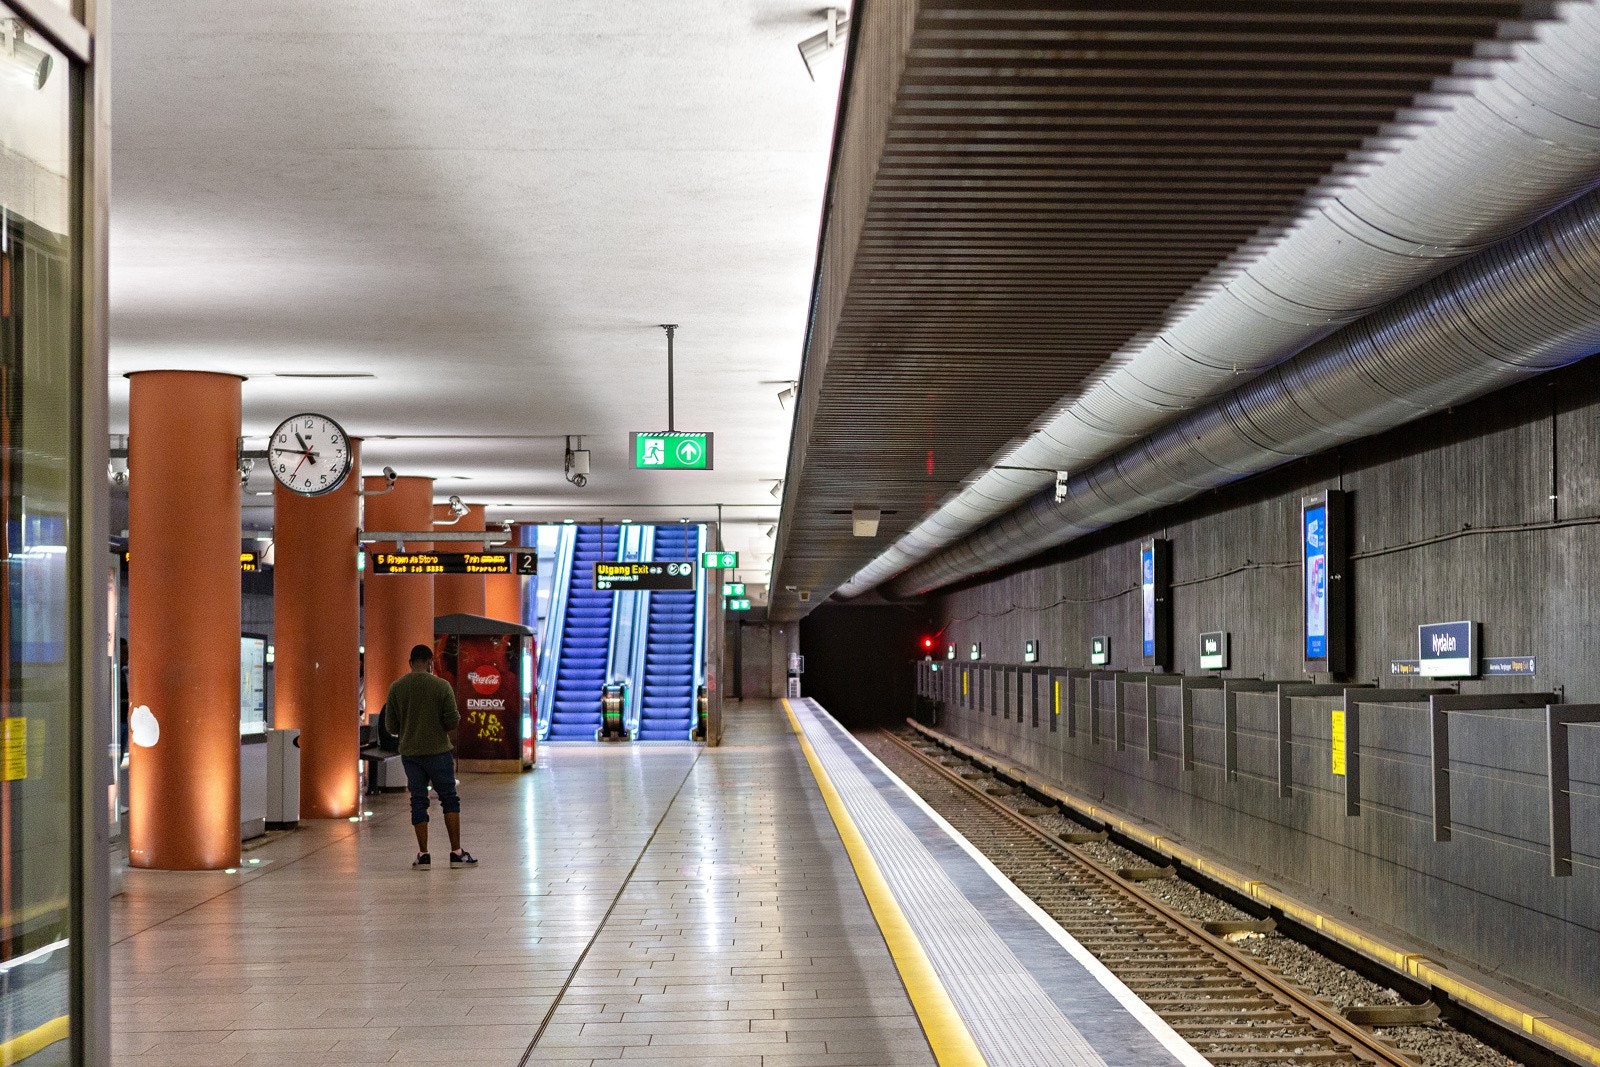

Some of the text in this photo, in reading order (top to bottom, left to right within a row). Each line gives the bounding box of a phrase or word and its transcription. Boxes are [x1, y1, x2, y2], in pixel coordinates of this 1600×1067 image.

[290, 423, 298, 433] 11
[304, 419, 314, 429] 12
[279, 434, 287, 443] 10
[331, 434, 339, 444] 2
[336, 449, 343, 458] 3
[279, 464, 286, 473] 8
[330, 464, 338, 473] 4
[290, 475, 296, 484] 7
[304, 479, 312, 488] 6
[320, 475, 327, 484] 5
[523, 555, 532, 568] 2
[597, 564, 649, 576] Utgang Exit
[1432, 633, 1457, 656] Nydalen
[467, 699, 505, 707] ENERGY
